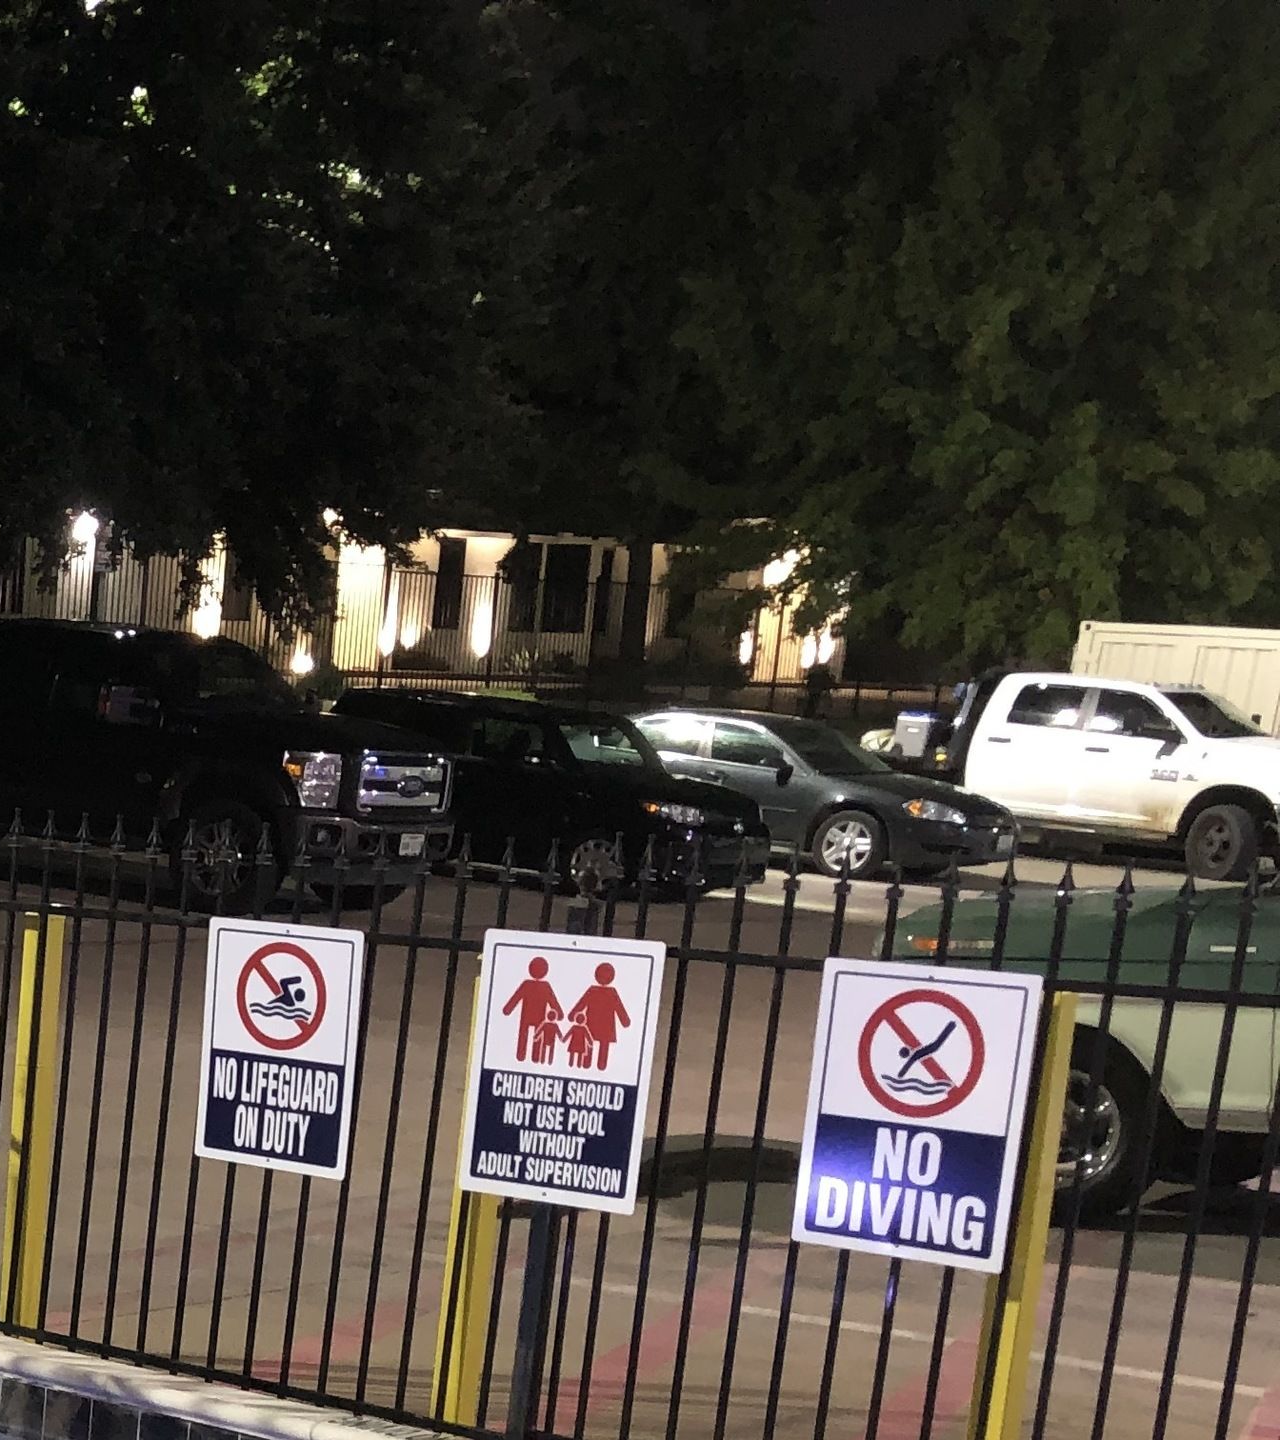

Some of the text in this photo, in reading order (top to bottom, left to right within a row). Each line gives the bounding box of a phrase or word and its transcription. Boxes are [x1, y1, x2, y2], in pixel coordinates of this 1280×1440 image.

[213, 1056, 339, 1115] NO LIFEGUARD
[492, 1072, 625, 1111] CHILDREN SHOULD
[233, 1104, 310, 1157] ON DUTY
[503, 1101, 605, 1137] NOT USE POOL
[519, 1129, 585, 1161] WITHOUT
[872, 1127, 942, 1187] NO
[476, 1151, 622, 1194] ADULT SUPERVISION
[815, 1175, 987, 1251] DIVING
